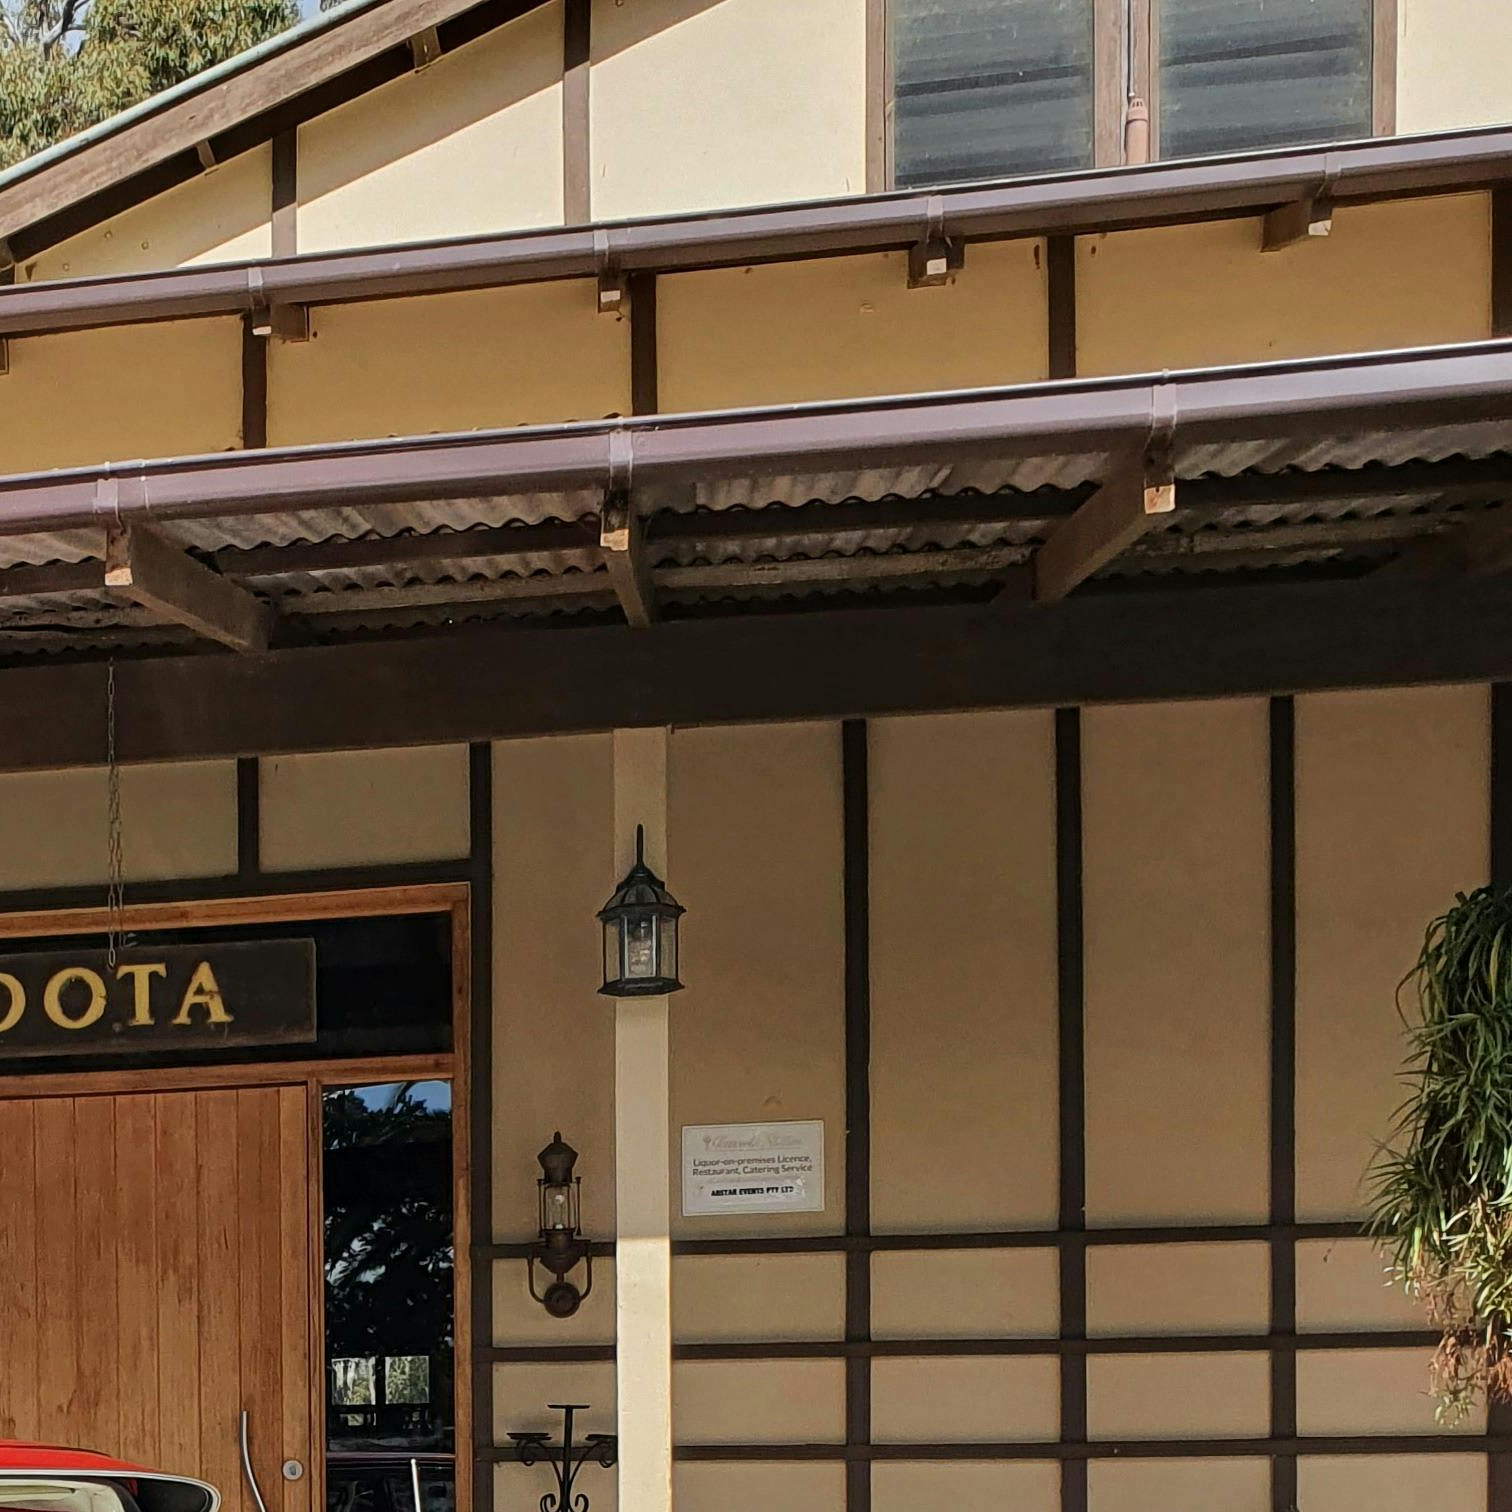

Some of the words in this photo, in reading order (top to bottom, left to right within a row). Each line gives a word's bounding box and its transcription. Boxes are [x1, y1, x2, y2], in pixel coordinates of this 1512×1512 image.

[743, 1166, 780, 1174] Catering
[781, 1164, 813, 1172] Service
[739, 1187, 764, 1195] EVENTS
[766, 1186, 779, 1194] PTY
[781, 1185, 794, 1193] LTD
